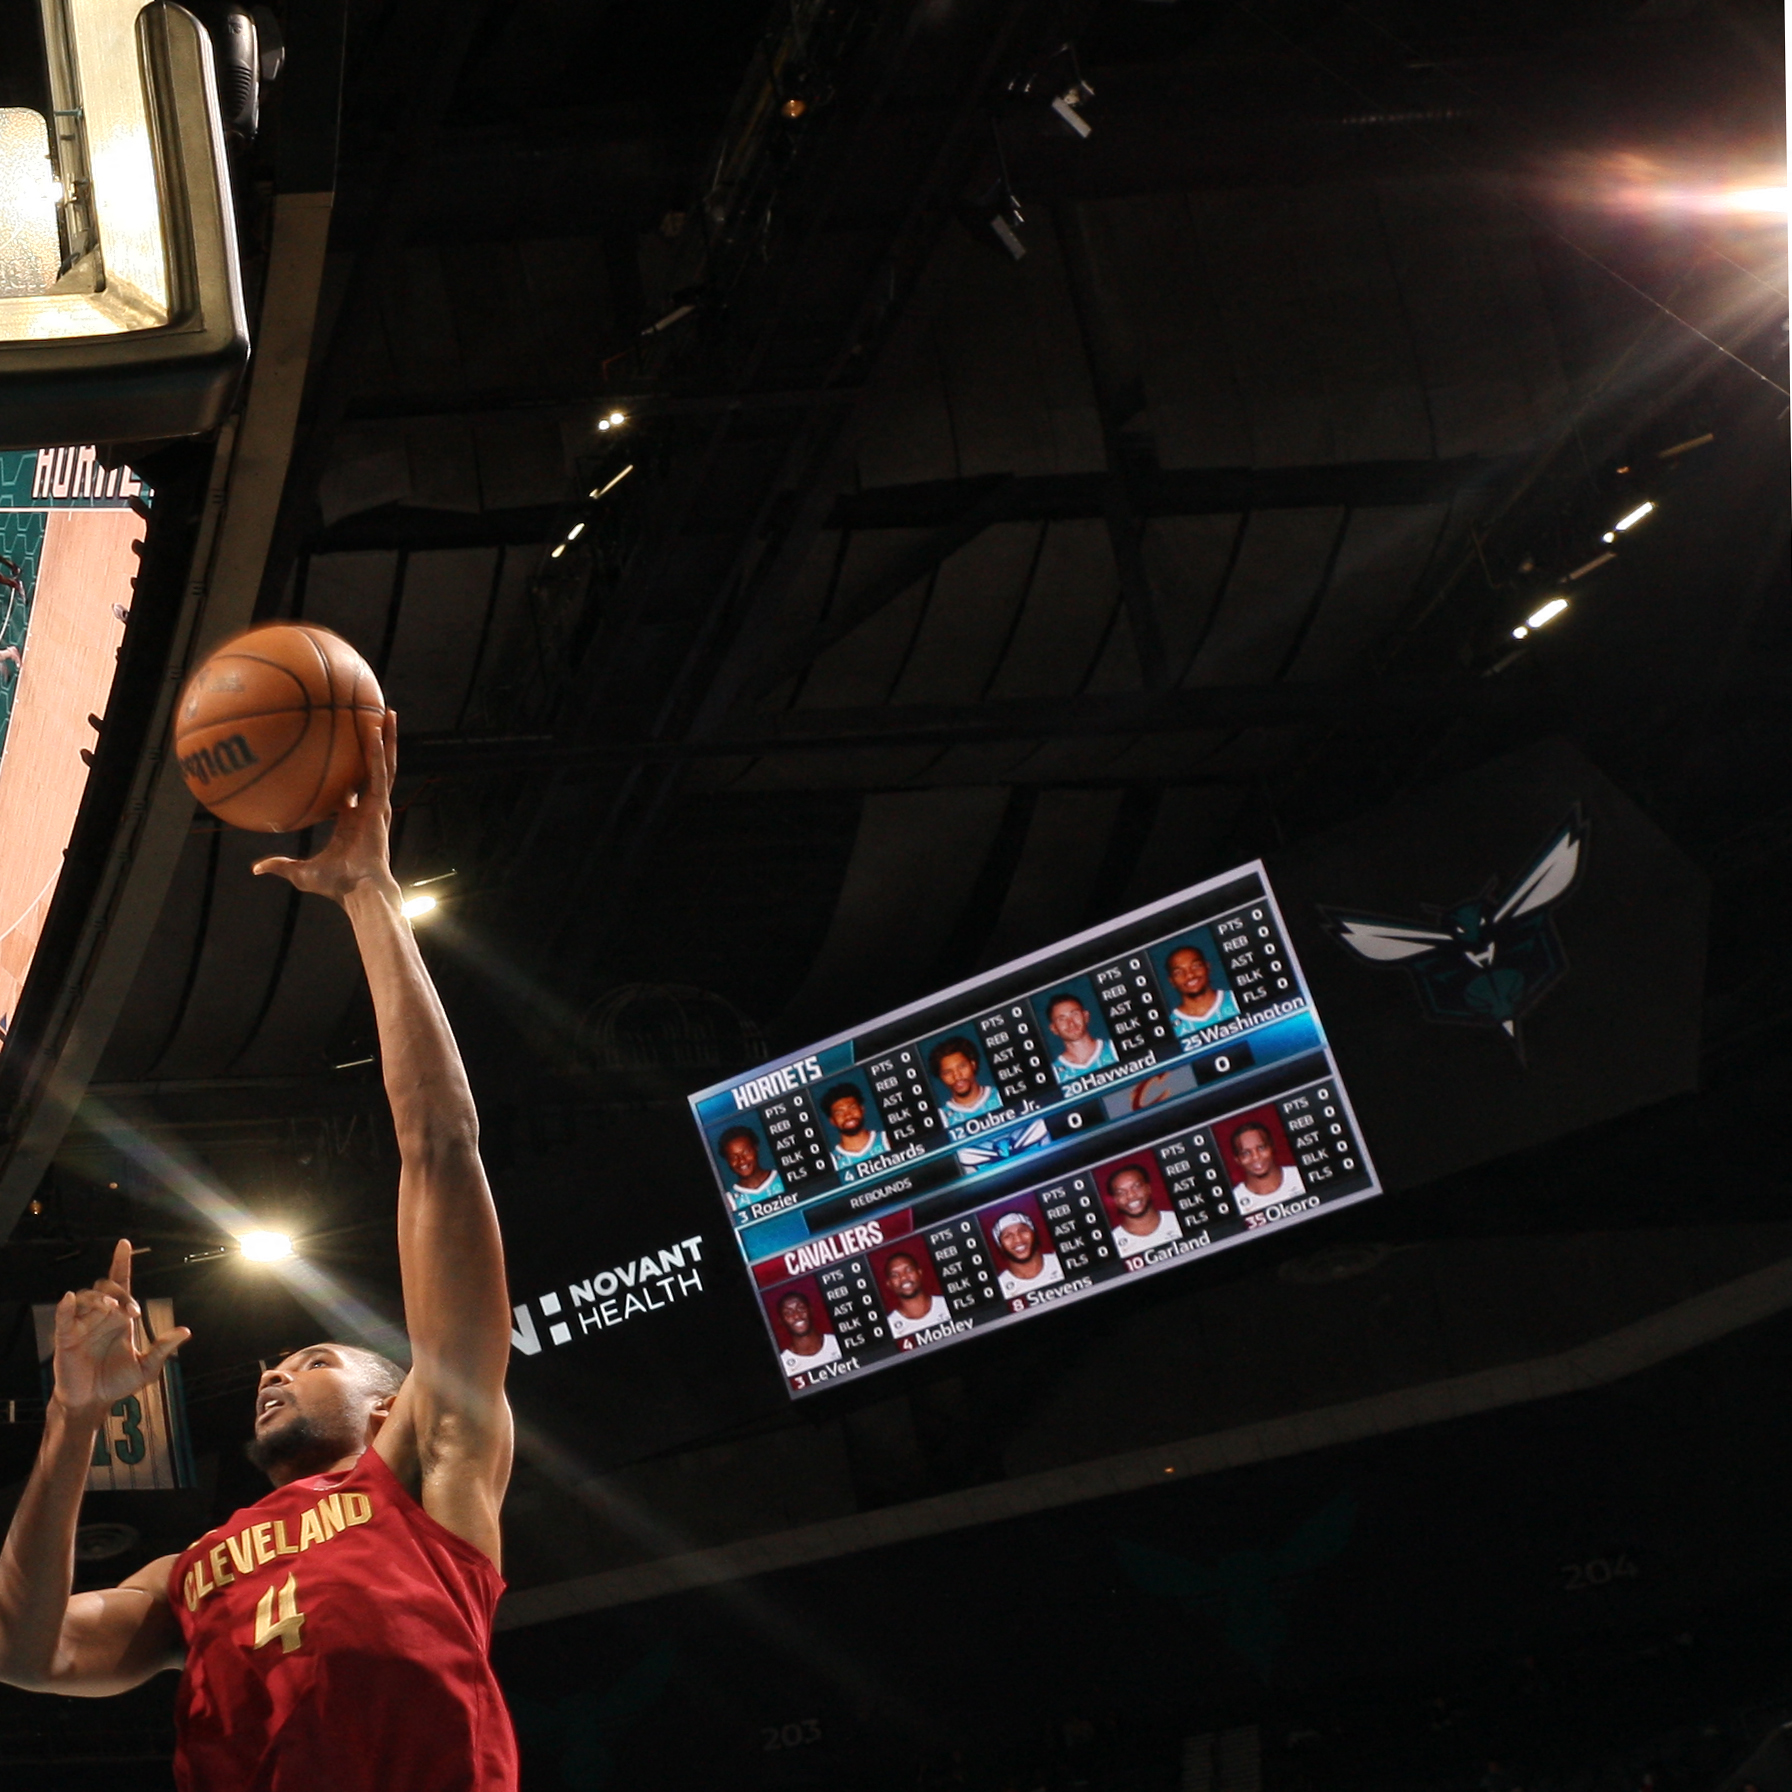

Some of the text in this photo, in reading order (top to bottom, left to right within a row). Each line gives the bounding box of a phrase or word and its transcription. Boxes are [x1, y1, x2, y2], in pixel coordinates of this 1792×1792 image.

[1182, 1034, 1201, 1051] 25
[1215, 1056, 1231, 1073] 0
[732, 1056, 823, 1111] HORNETS
[1062, 1081, 1081, 1098] 20
[949, 1099, 1041, 1142] 12 Oubre Jr.
[1068, 1112, 1083, 1130] 0
[844, 1142, 926, 1182] 4 Richards
[738, 1191, 799, 1224] 3 Rozier
[850, 1177, 912, 1209] REBOUNDS
[1266, 1195, 1320, 1223] Okoro
[784, 1221, 885, 1276] CAVALIERS
[1125, 1229, 1211, 1272] 10 Garland
[568, 1235, 703, 1308] NOVANT
[578, 1268, 703, 1335] HEALTH
[1013, 1274, 1093, 1311] 8 Stevens
[903, 1338, 914, 1350] 4
[795, 1356, 860, 1389] 3 LeVert
[183, 1492, 374, 1613] CLEVELAND
[253, 1571, 305, 1654] 4
